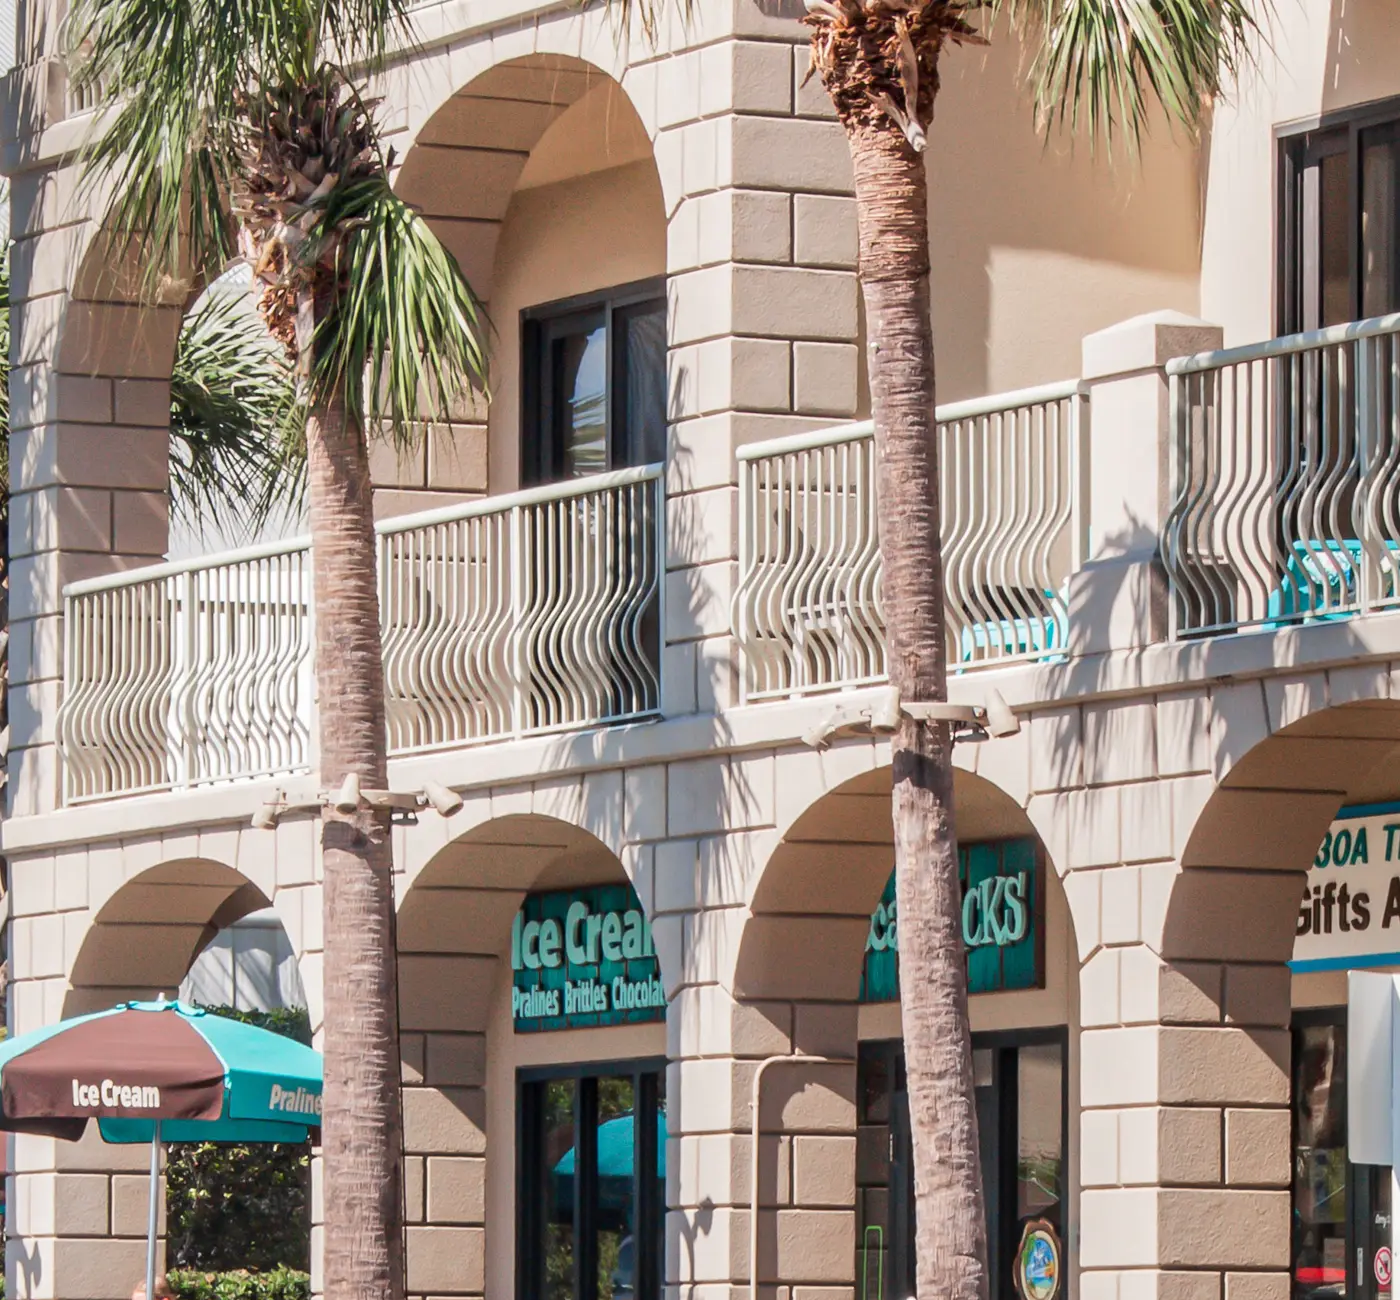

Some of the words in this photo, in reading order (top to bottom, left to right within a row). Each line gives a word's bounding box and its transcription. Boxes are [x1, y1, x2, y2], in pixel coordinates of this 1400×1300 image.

[1383, 824, 1400, 861] T
[961, 871, 1027, 946] CKS
[511, 909, 561, 970] Ice
[511, 984, 559, 1018] Pralines
[564, 978, 607, 1014] Brittles
[72, 1079, 100, 1106] Ice
[101, 1079, 161, 1108] Cream
